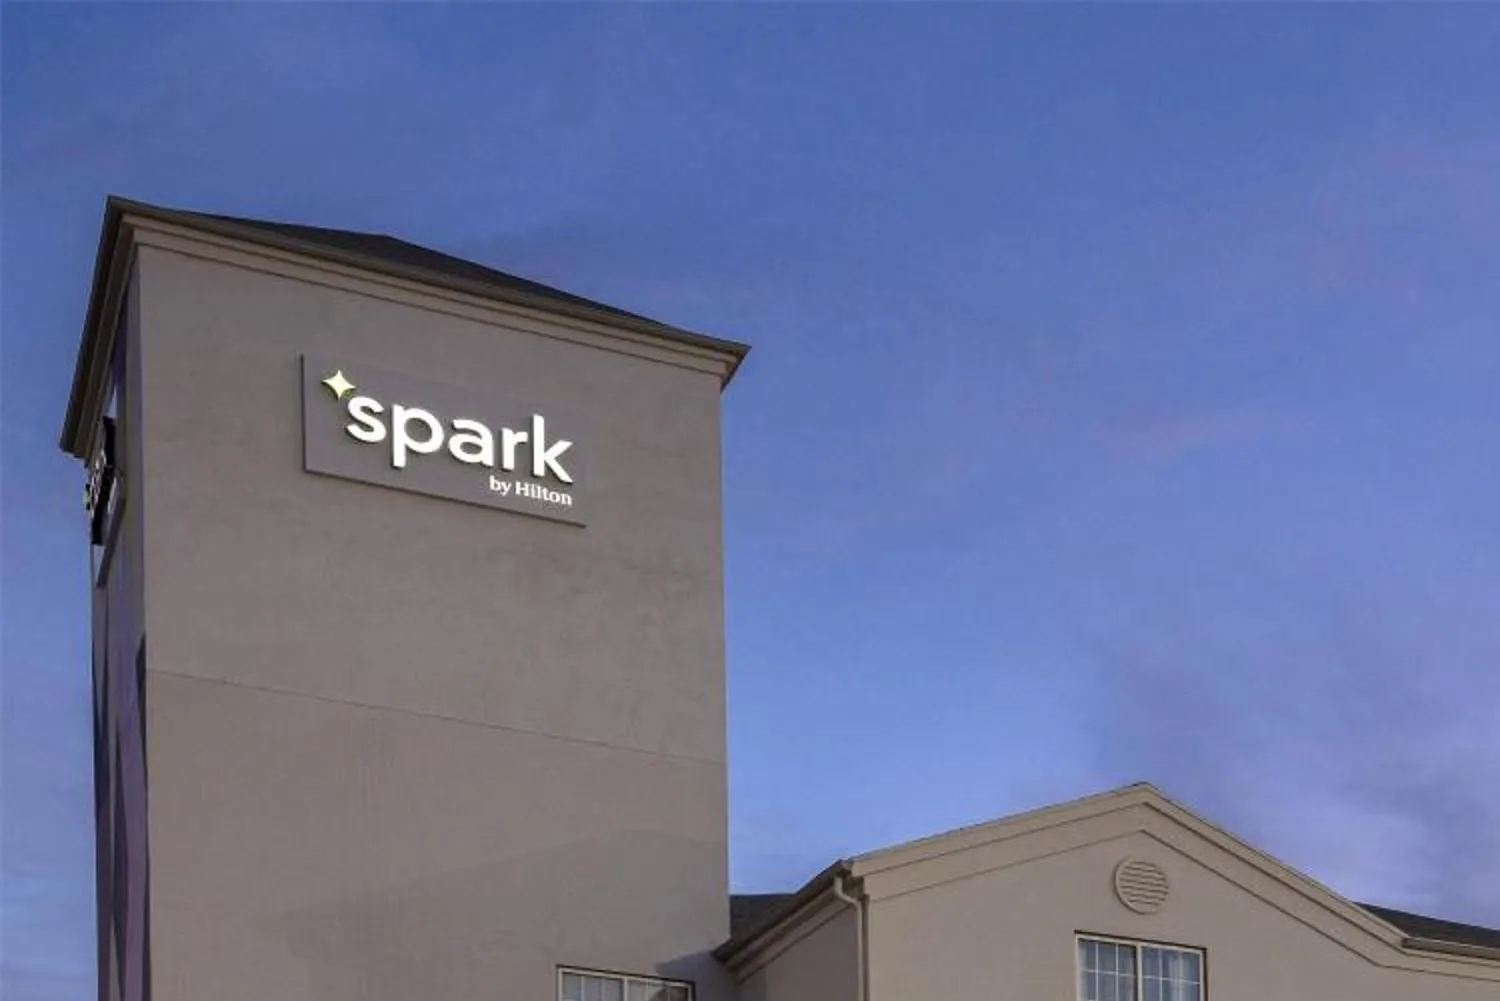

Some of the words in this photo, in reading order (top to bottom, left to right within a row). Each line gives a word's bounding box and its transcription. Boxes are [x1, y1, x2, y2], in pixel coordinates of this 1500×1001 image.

[345, 396, 574, 484] spark
[489, 475, 512, 496] by
[515, 480, 573, 506] Hilton
